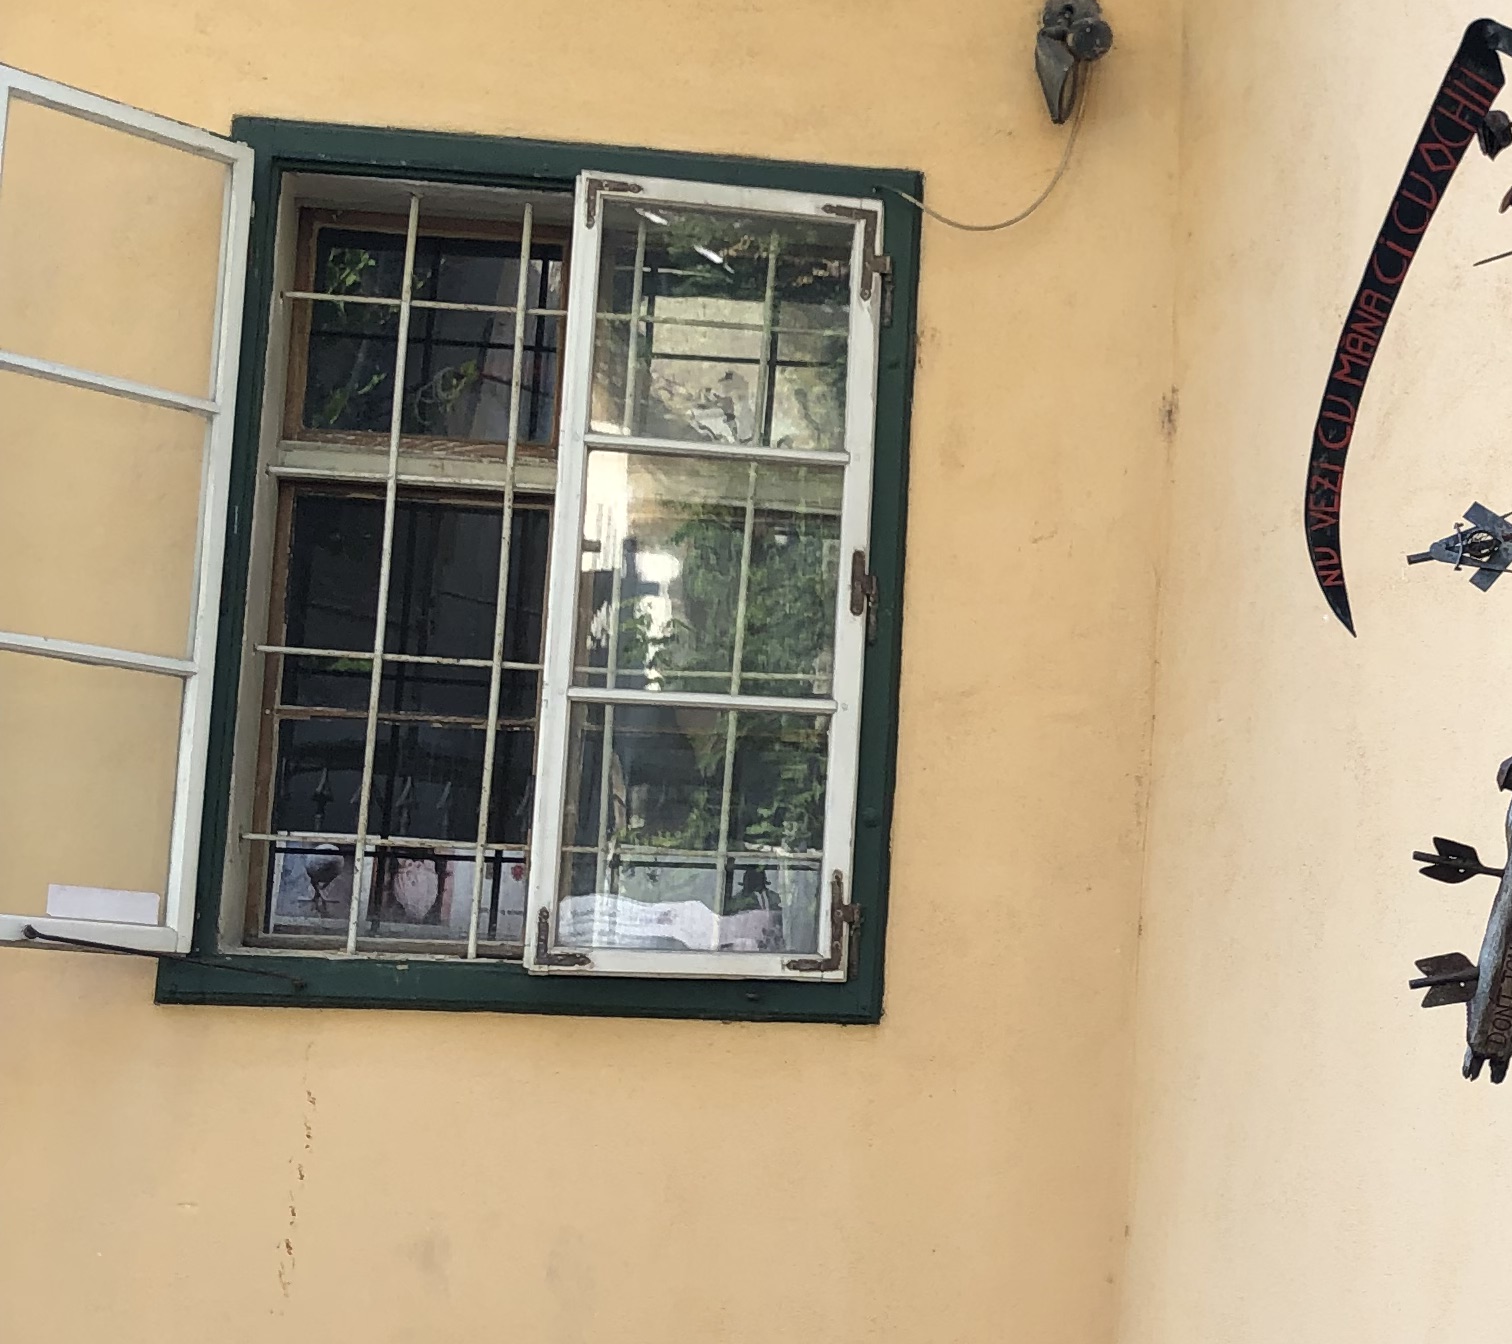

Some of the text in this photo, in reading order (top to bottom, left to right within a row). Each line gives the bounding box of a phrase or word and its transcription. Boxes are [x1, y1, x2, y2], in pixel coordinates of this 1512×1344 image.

[1418, 62, 1501, 172] OCHII
[1392, 169, 1440, 235] CU
[1317, 395, 1354, 450] CU
[1308, 461, 1344, 532] VEZI
[1318, 547, 1345, 588] NU
